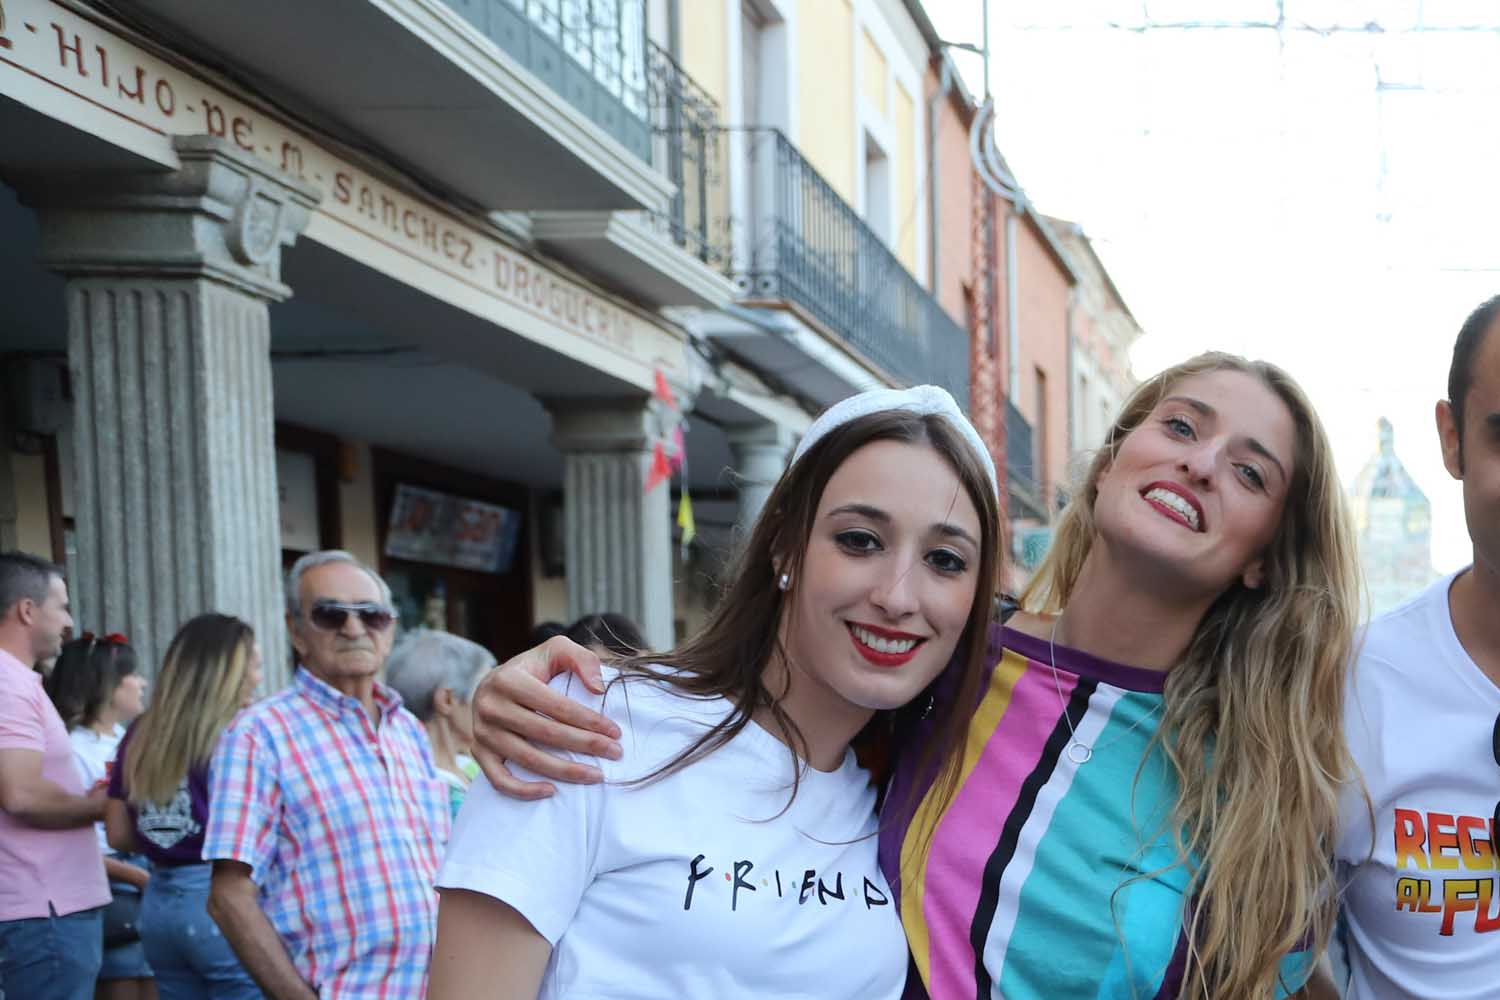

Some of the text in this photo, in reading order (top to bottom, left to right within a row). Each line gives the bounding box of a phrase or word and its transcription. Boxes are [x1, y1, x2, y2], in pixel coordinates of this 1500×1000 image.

[51, 22, 175, 117] HIJO
[202, 99, 255, 151] DE
[335, 171, 475, 270] SANCHEZ
[684, 854, 888, 912] FRIEND
[1396, 876, 1441, 912] AL
